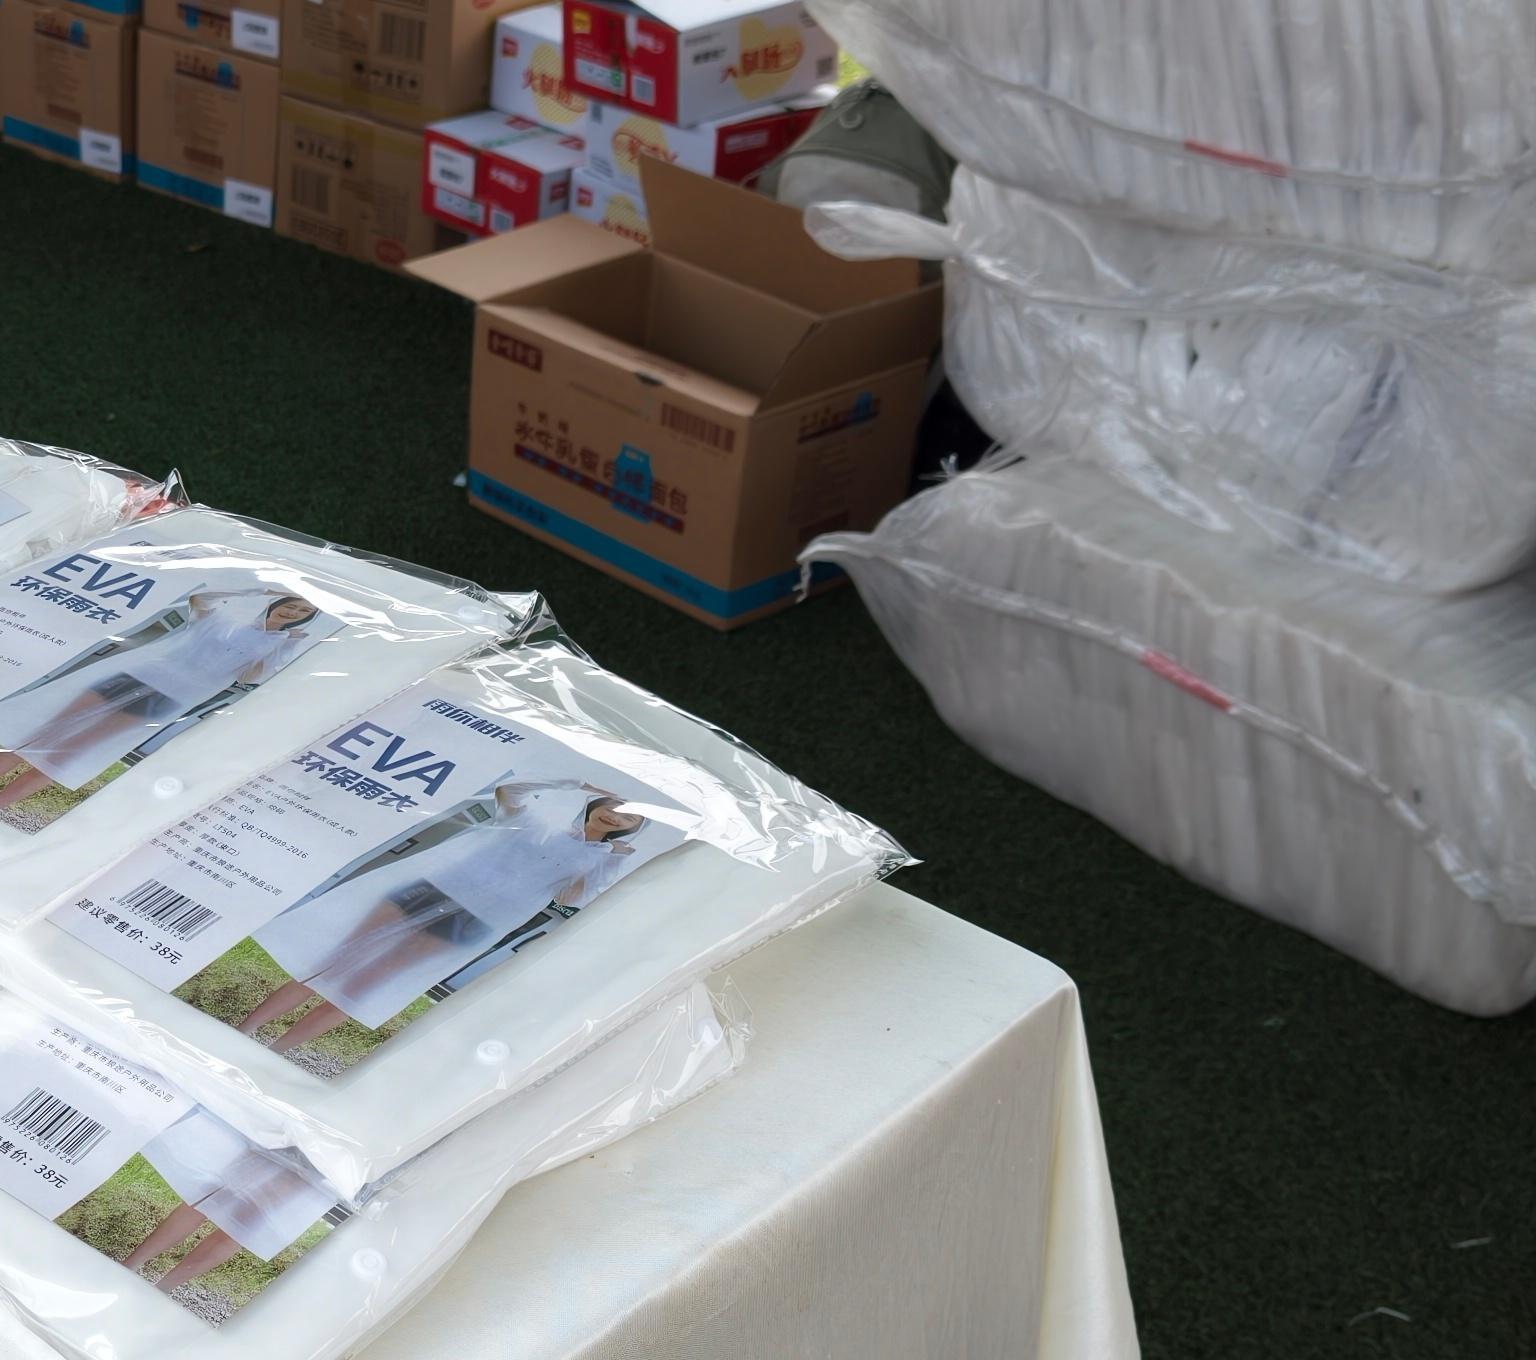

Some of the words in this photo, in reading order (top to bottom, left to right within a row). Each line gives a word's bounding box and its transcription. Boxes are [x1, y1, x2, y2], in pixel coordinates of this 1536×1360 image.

[9, 575, 123, 626] 环保雨衣
[42, 552, 157, 610] EVA
[291, 750, 422, 815] 环保雨衣
[326, 720, 457, 798] EVA
[74, 897, 184, 967] 建议零售价：38元
